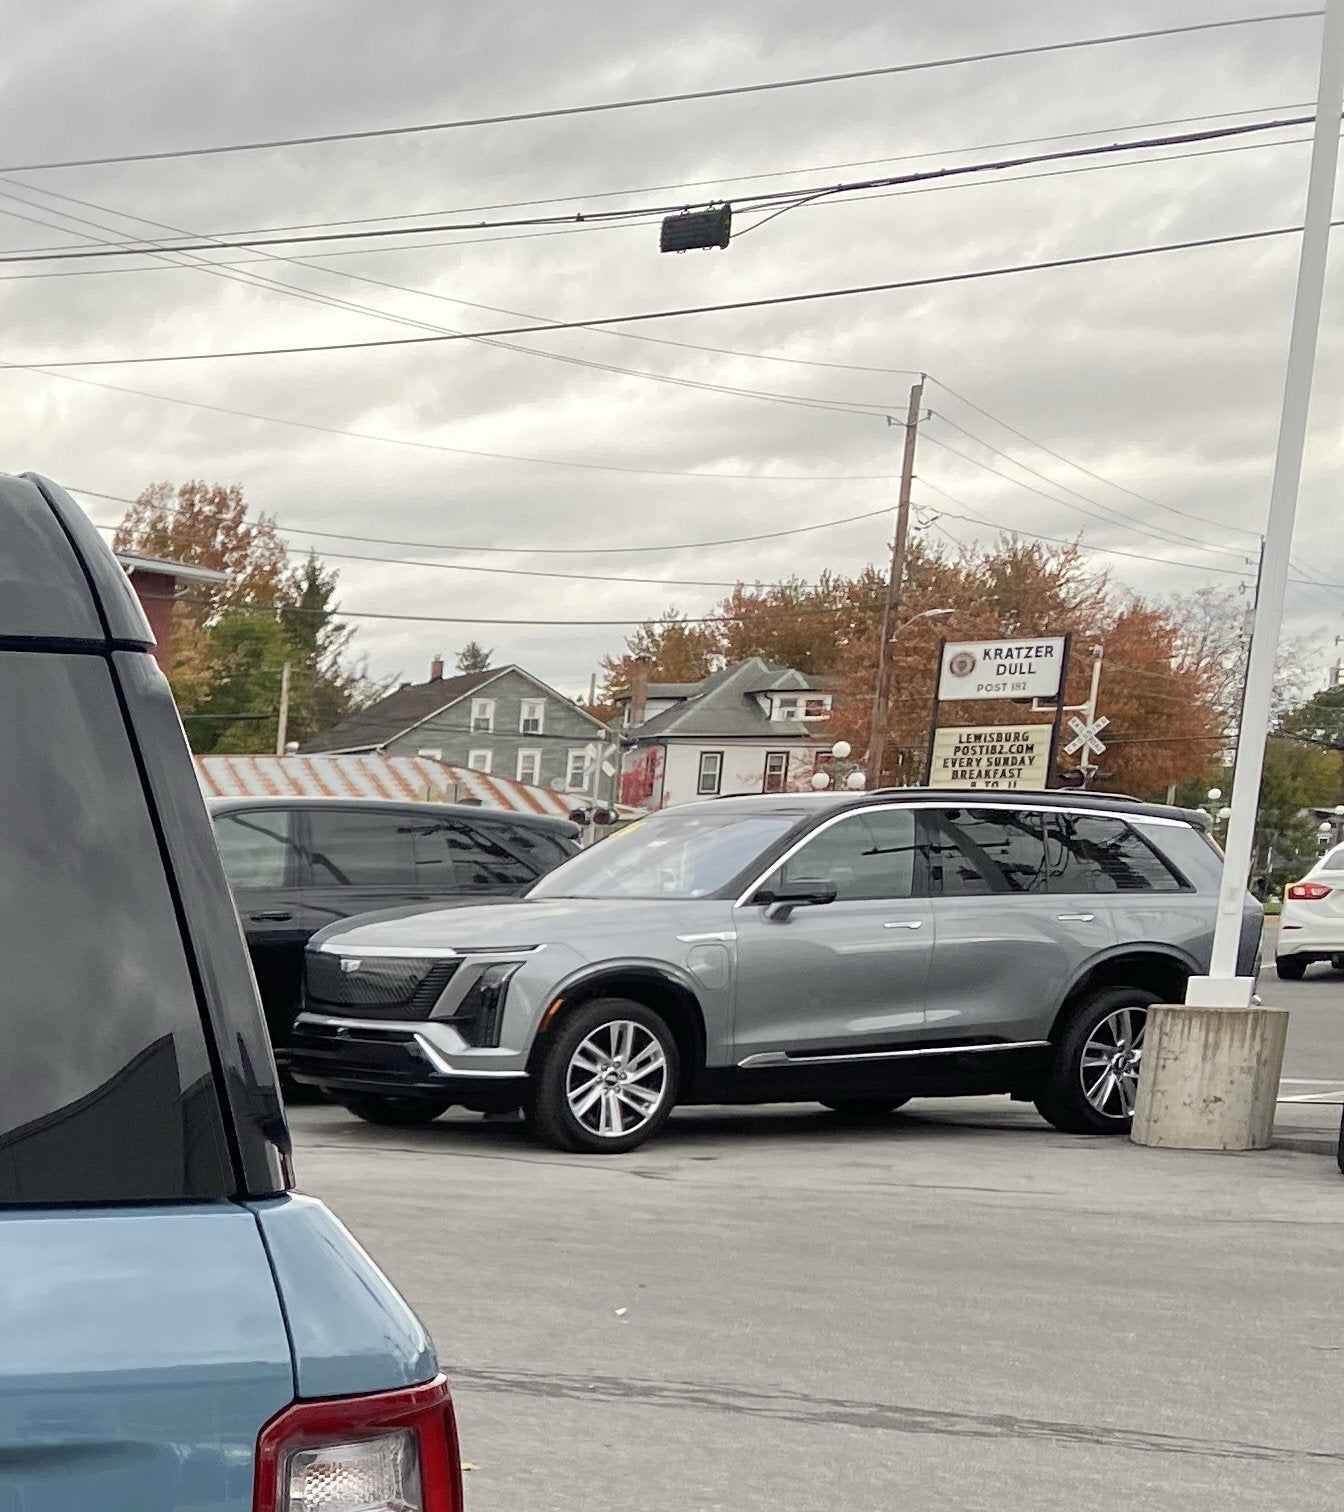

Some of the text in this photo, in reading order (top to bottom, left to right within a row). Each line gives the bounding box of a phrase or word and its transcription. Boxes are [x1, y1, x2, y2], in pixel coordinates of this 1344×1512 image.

[983, 645, 1054, 661] KRATZER
[995, 662, 1036, 676] DULL
[976, 682, 1027, 692] POST 182
[958, 732, 1030, 744] LEWISBURG
[943, 756, 1035, 768] EVERY SUNDAY
[952, 768, 1023, 780] BREAKFAST
